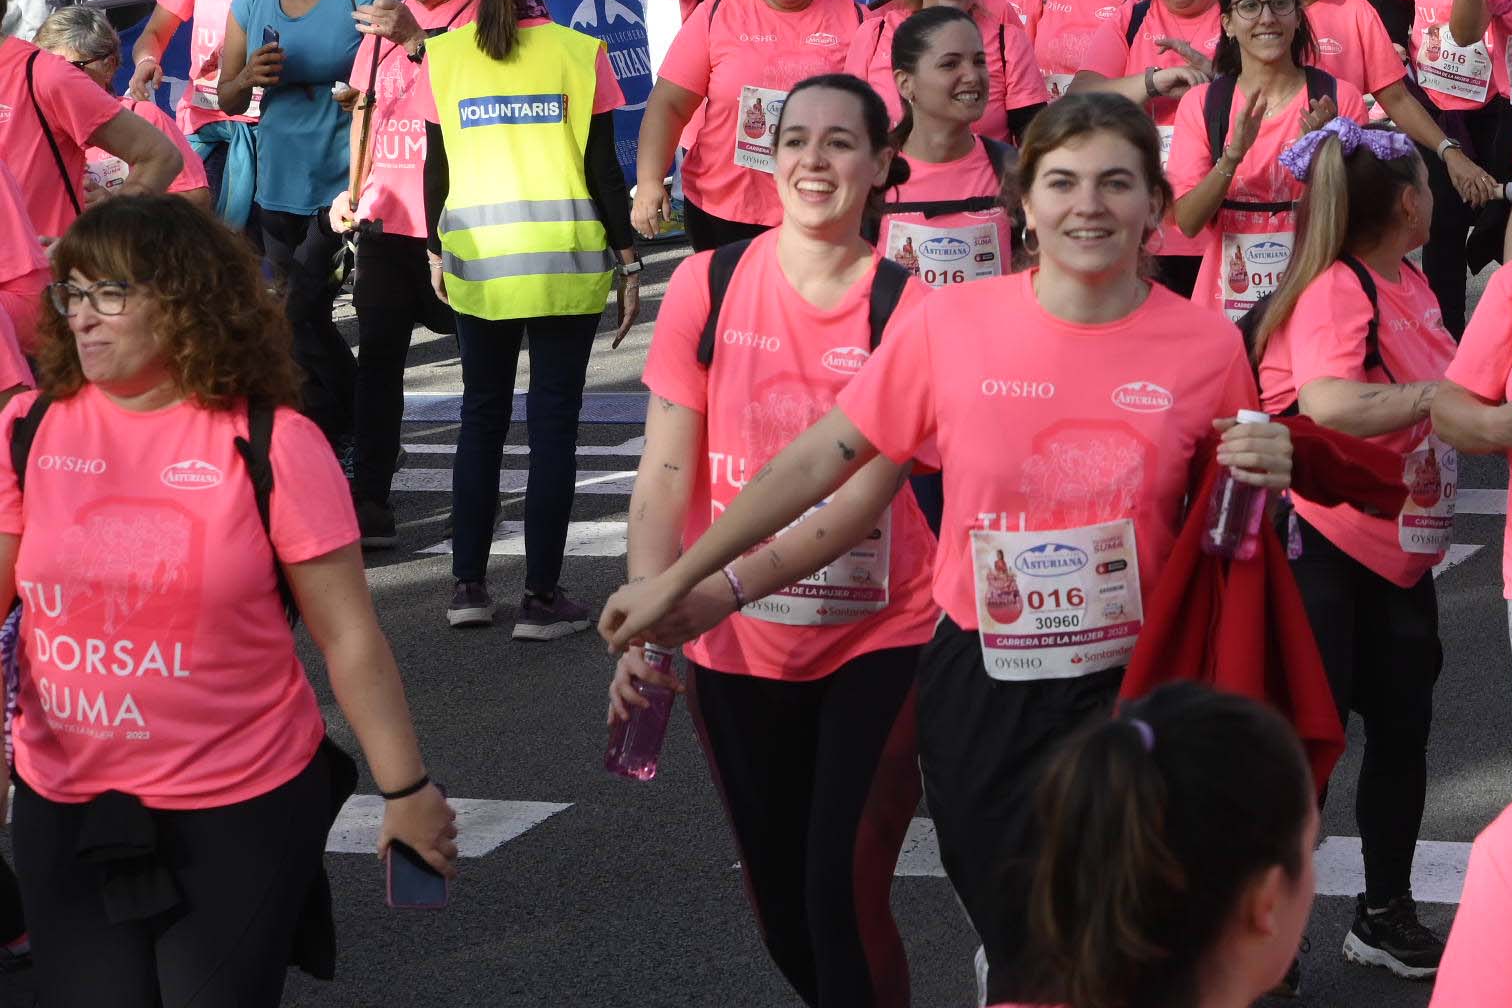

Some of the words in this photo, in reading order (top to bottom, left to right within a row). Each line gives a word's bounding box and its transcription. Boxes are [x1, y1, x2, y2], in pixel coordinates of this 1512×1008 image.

[1442, 50, 1466, 65] 016
[1443, 62, 1459, 73] 2513
[460, 100, 559, 123] VOLUNTARIS
[375, 134, 427, 162] SUM
[743, 154, 769, 167] OYSHO
[924, 245, 967, 256] ASTURIANA
[924, 269, 965, 284] 016
[723, 328, 781, 353] OYSHO
[827, 355, 864, 368] ASTURIA
[981, 378, 1055, 400] OYSHO
[1117, 390, 1171, 407] ASTURIANA
[38, 454, 107, 475] OYSHO
[708, 452, 748, 488] TU
[168, 471, 218, 483] ASTURIANA
[1021, 556, 1083, 570] ASTURIANA
[1094, 541, 1124, 553] SUMA
[20, 580, 62, 618] TU
[819, 589, 850, 597] MUJER
[1027, 587, 1085, 610] 016
[1035, 614, 1080, 630] 30960
[996, 636, 1039, 647] CARRERA
[1041, 635, 1055, 645] DE
[1056, 634, 1069, 644] LA
[1071, 631, 1104, 642] MUJER
[1107, 627, 1128, 637] 2023
[34, 627, 192, 677] DORSAL
[995, 657, 1042, 670] OYSHO
[39, 677, 146, 727] SUMA
[125, 730, 150, 741] 2023
